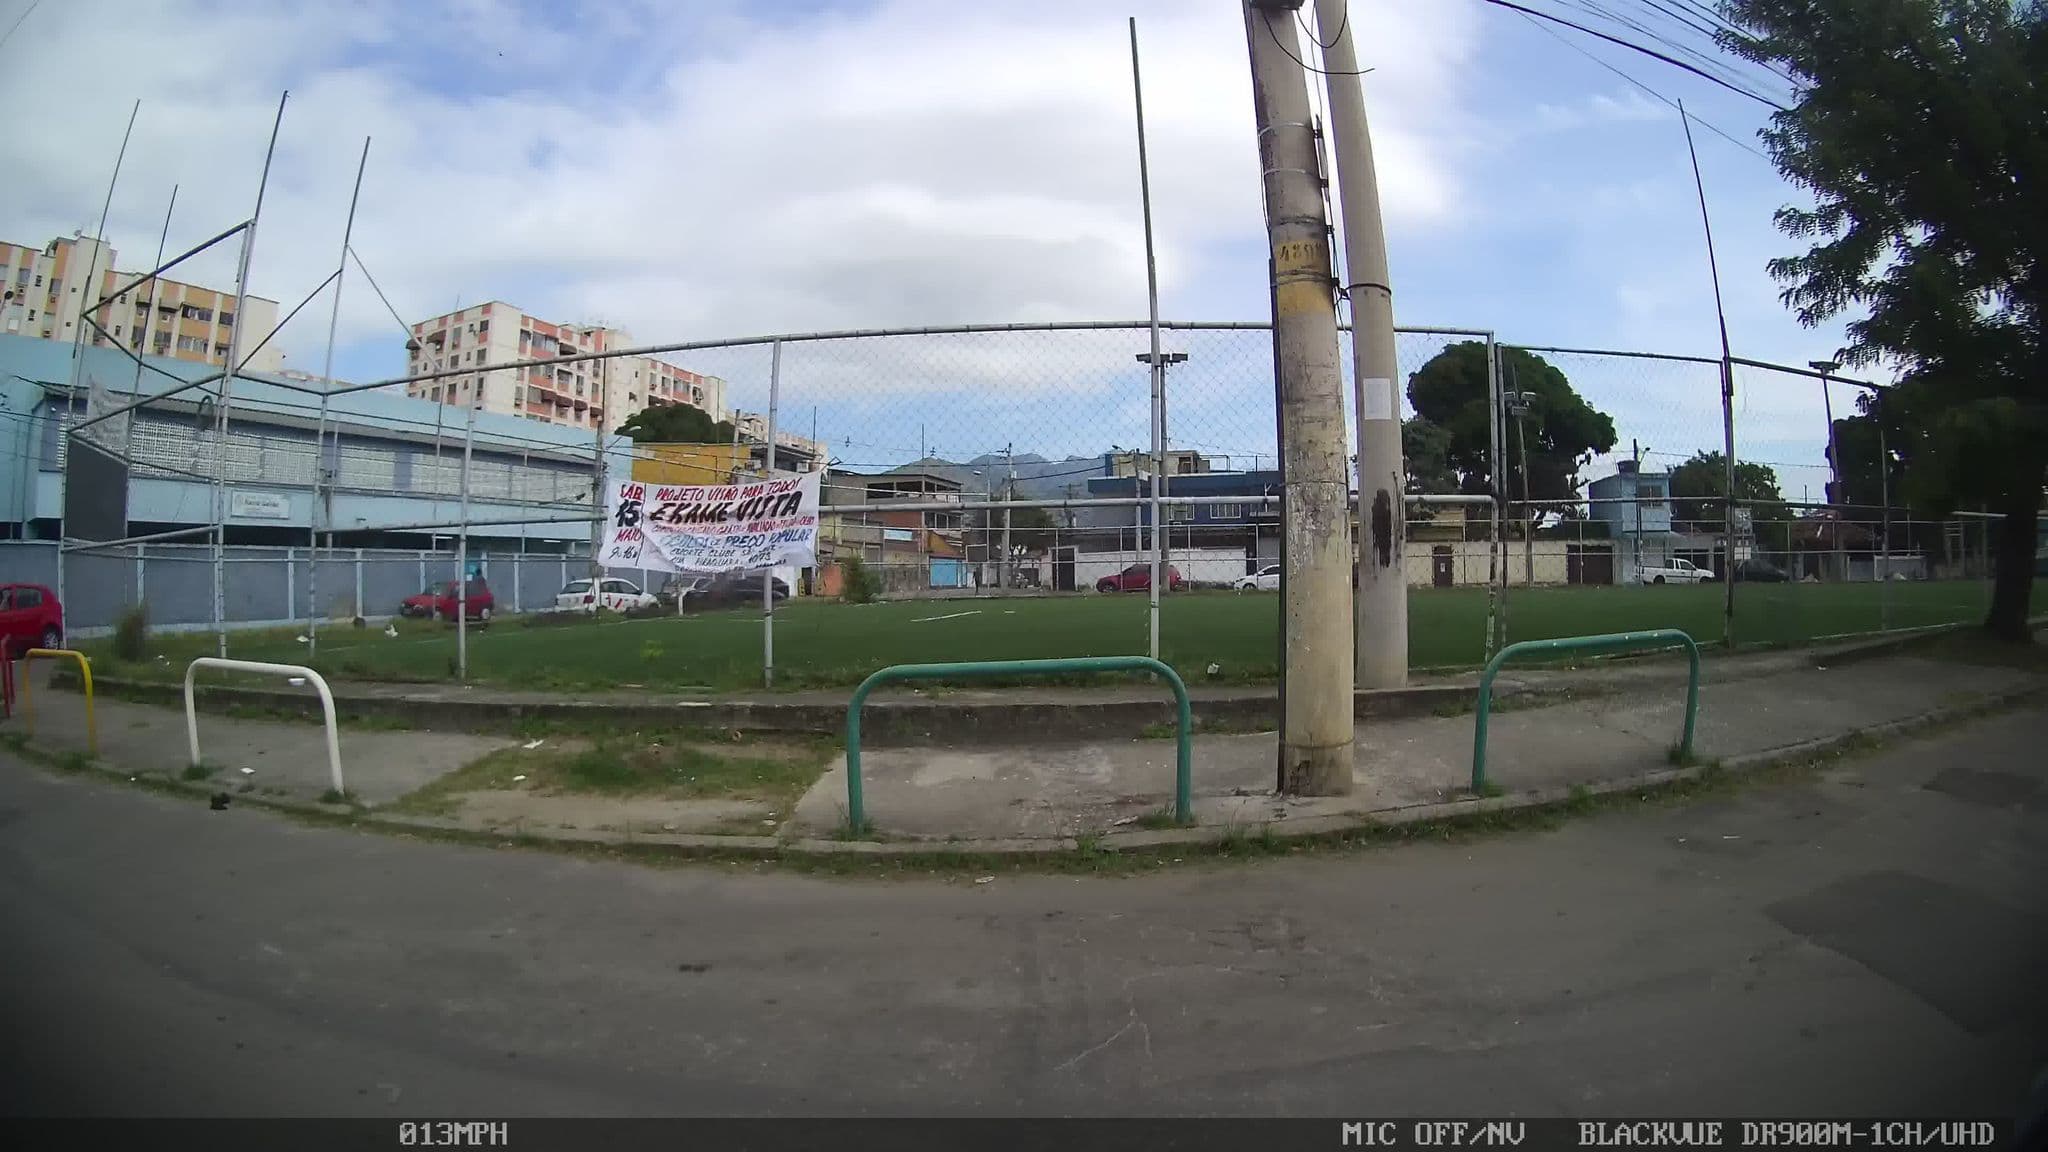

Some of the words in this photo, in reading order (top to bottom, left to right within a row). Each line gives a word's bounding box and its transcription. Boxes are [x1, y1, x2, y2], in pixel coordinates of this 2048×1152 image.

[655, 487, 704, 501] PROJETO
[707, 485, 738, 501] VISÃO
[740, 485, 764, 499] PARA
[615, 498, 643, 527] 15
[736, 491, 803, 522] VISTA
[613, 529, 643, 543] MAIO
[708, 549, 737, 558] CLUBE
